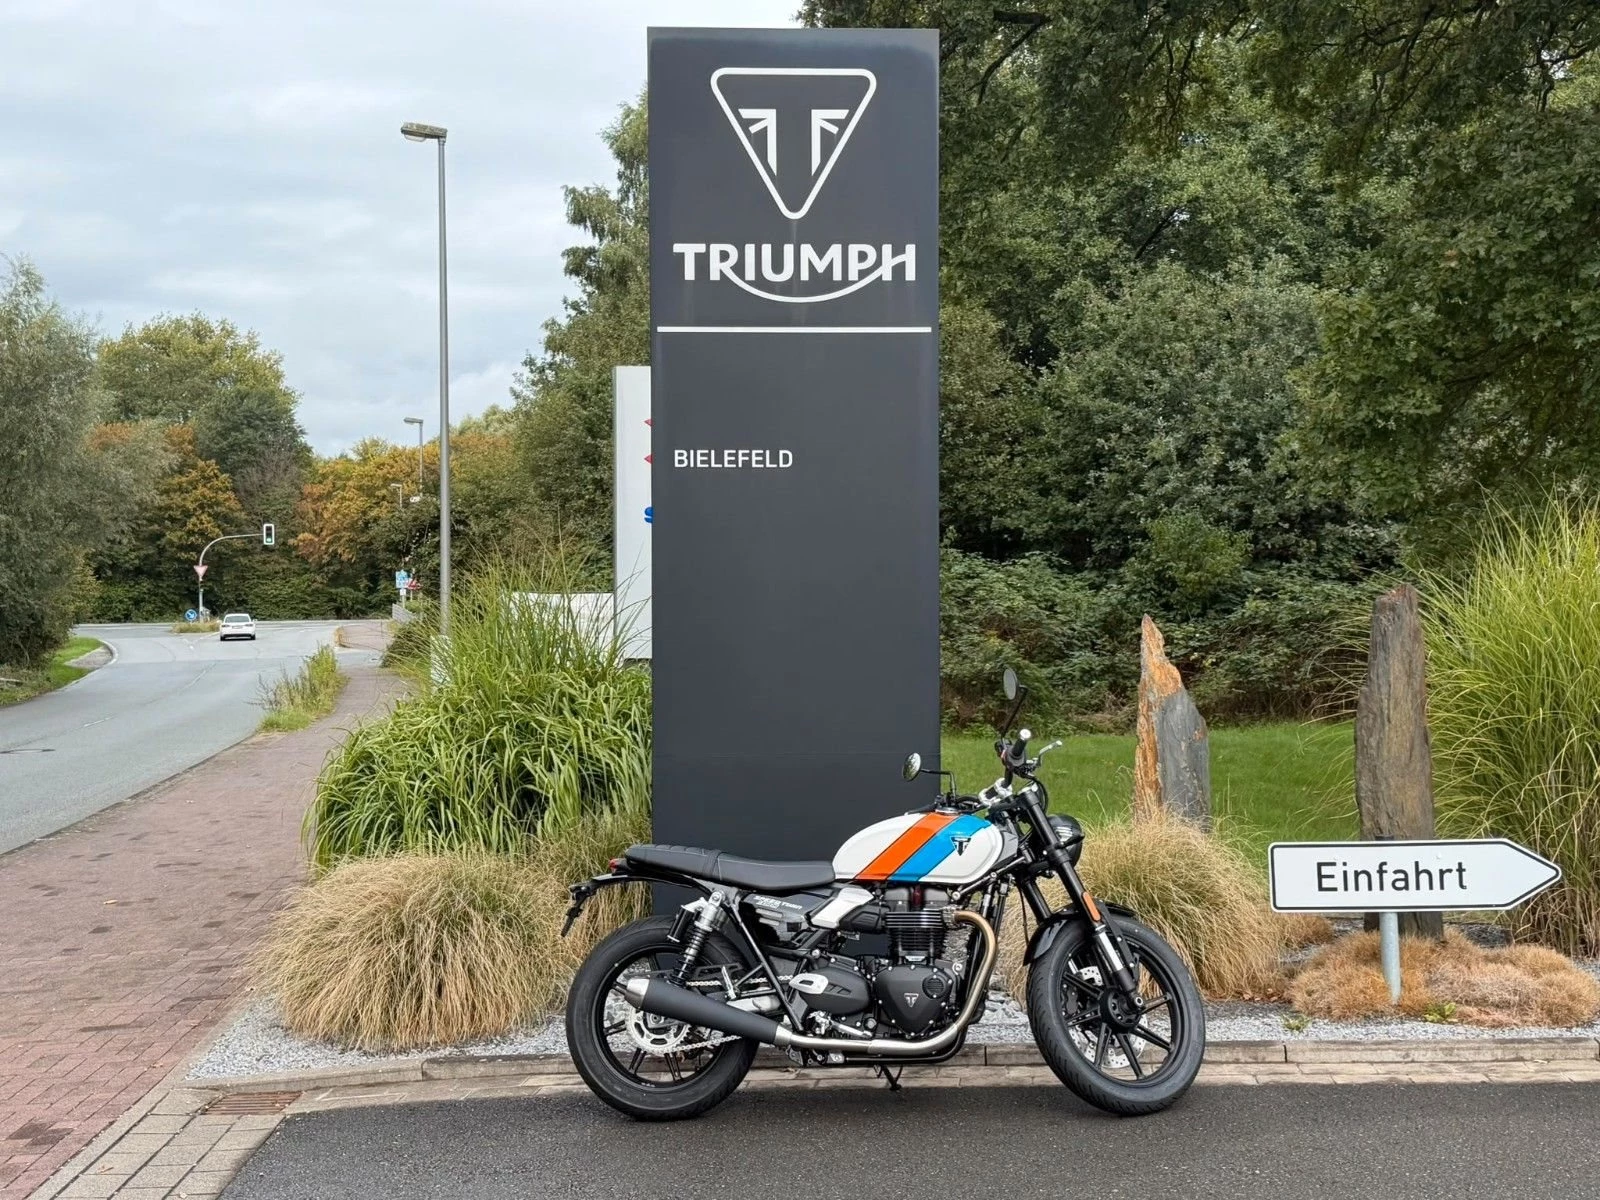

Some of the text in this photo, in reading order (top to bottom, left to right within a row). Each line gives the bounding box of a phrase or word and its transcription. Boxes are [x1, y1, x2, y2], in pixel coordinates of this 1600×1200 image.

[673, 243, 916, 303] TRIUMPH
[674, 449, 793, 468] BIELEFELD
[1316, 860, 1467, 892] Einfahrt
